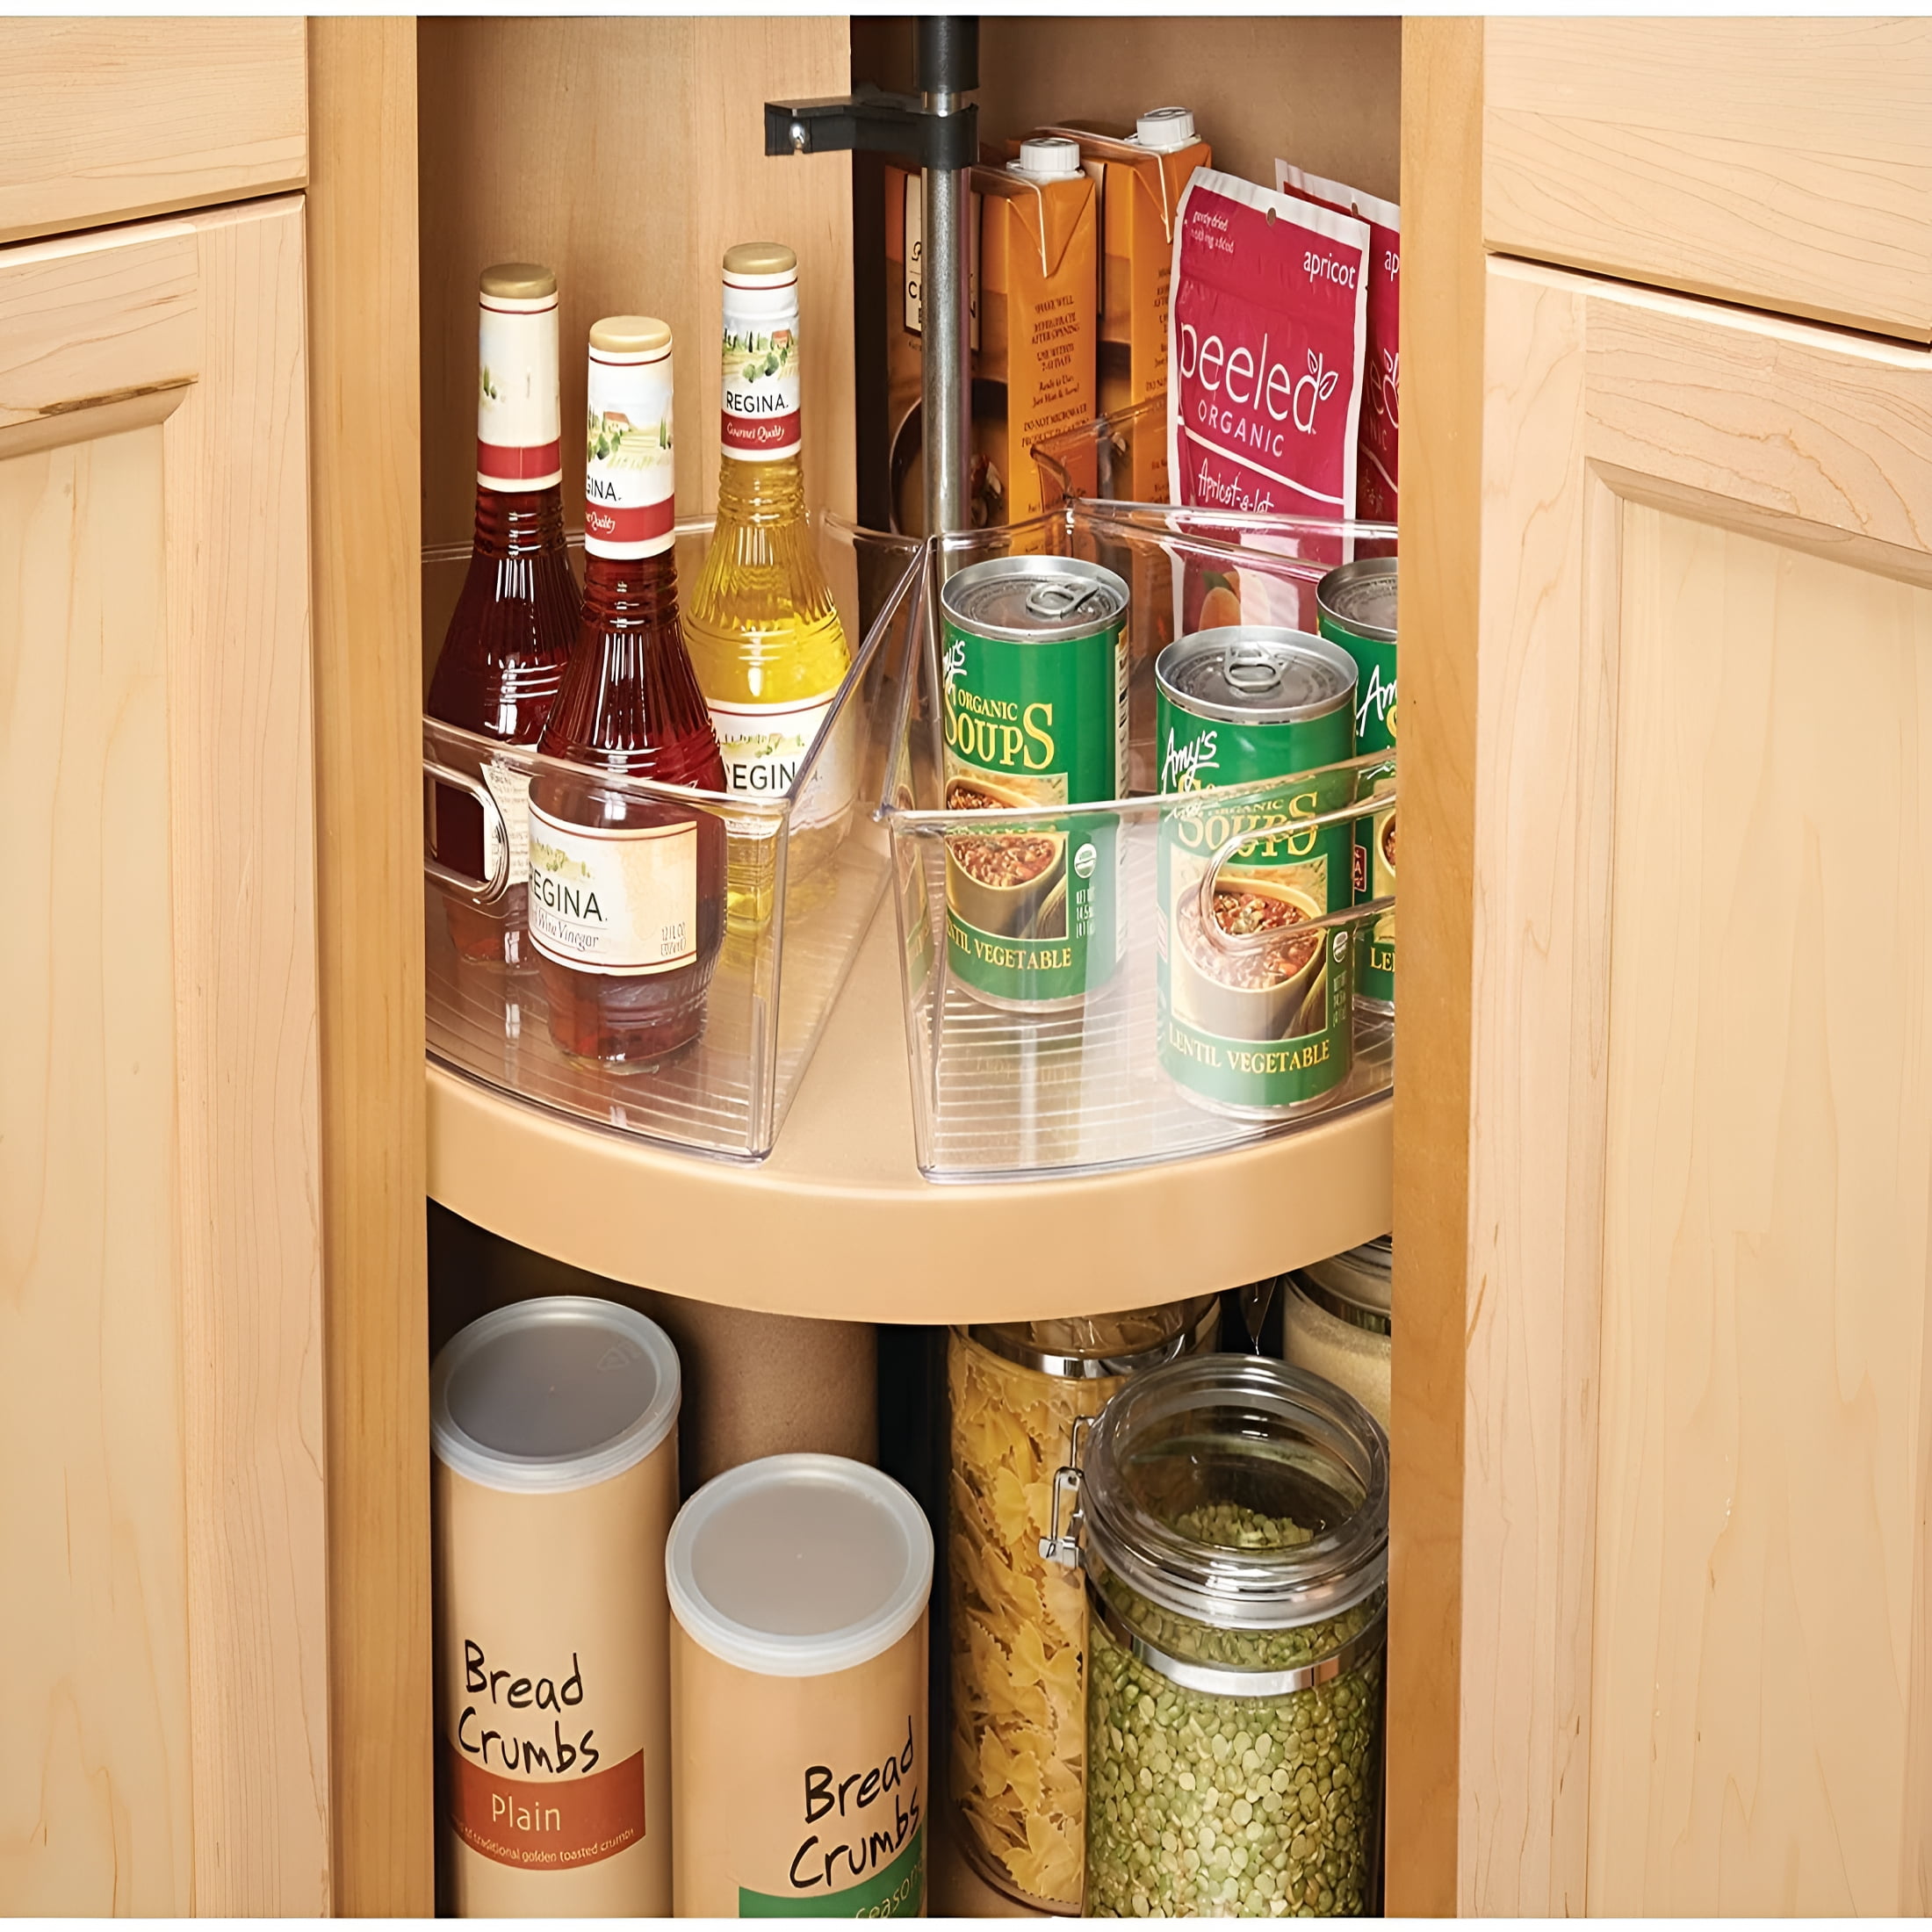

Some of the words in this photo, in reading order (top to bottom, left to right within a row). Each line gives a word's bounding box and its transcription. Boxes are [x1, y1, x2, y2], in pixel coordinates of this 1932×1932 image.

[1303, 251, 1356, 289] apricot
[1180, 322, 1326, 435] peeled
[1198, 400, 1285, 458] ORGANIC
[945, 682, 1055, 770] SOUPS
[958, 688, 1019, 721] ORGANIC
[1161, 727, 1220, 797] Amy's
[974, 938, 1072, 970] VEGETABLE
[1168, 1022, 1222, 1068] LENTIL
[1227, 1039, 1330, 1074] VEGETABLE
[465, 1639, 583, 1712] Bread
[458, 1706, 599, 1774] Crumbs
[805, 1714, 913, 1824] Bread
[492, 1792, 560, 1831] Plain
[789, 1785, 920, 1888] Crumbs
